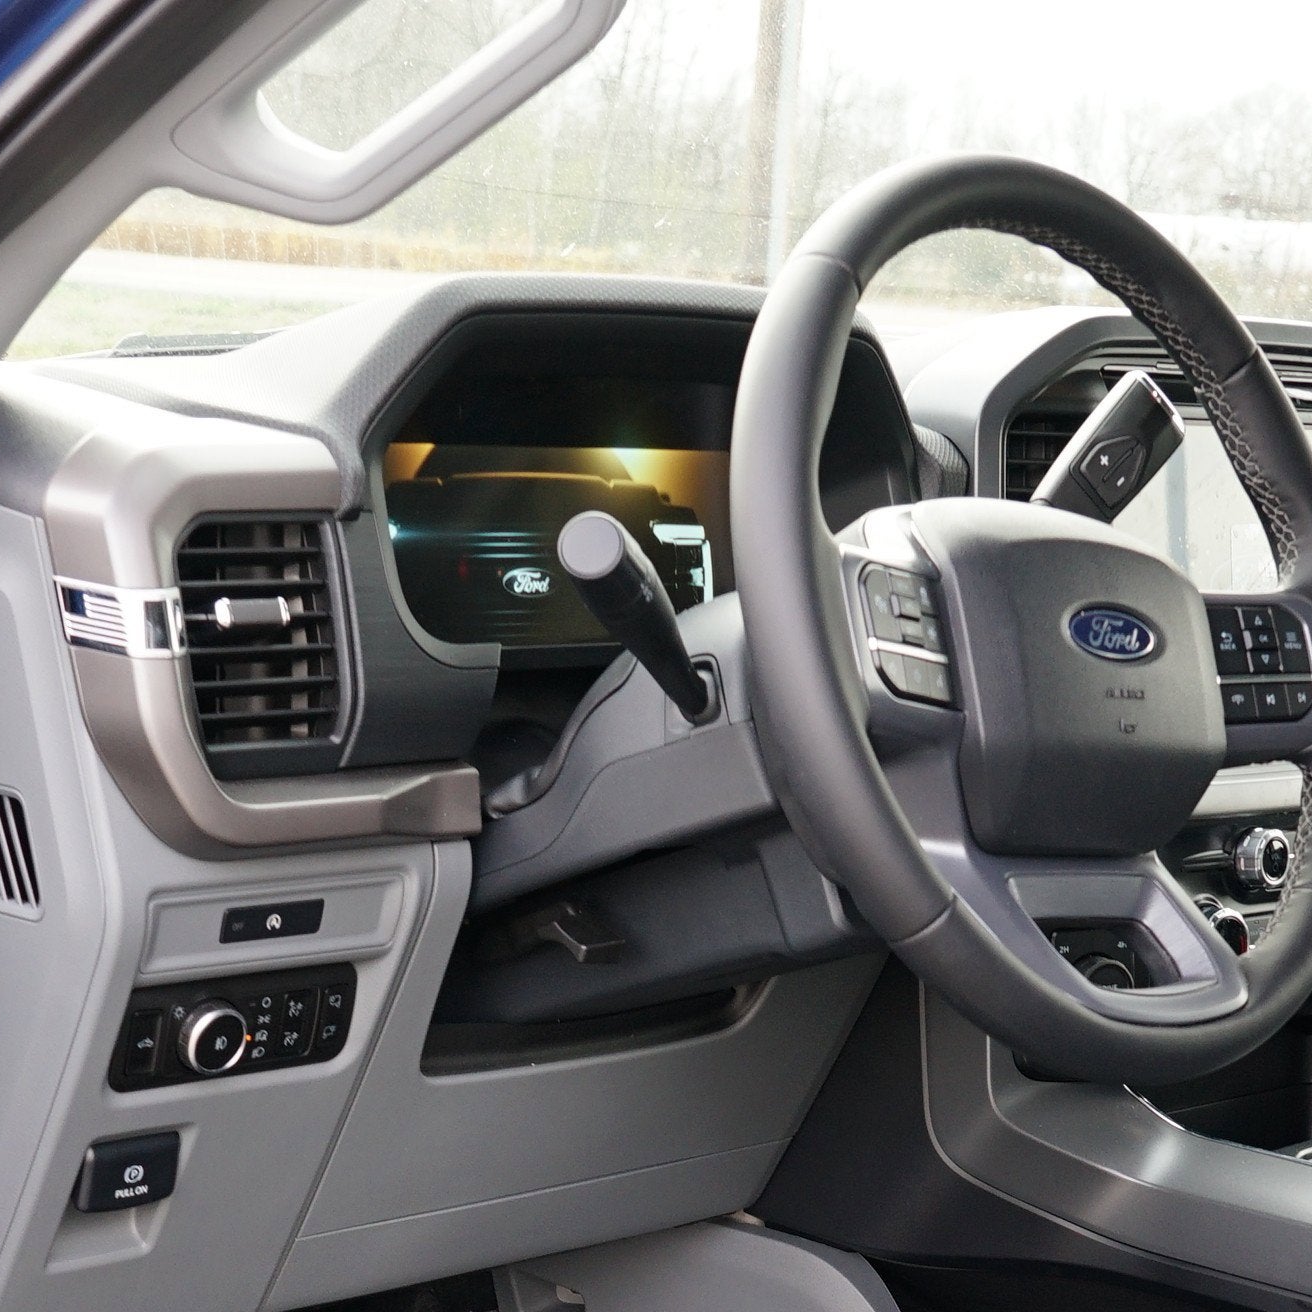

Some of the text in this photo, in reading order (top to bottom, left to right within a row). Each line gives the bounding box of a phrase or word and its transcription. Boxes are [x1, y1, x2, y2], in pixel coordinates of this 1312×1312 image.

[513, 571, 551, 594] Ford
[1088, 617, 1140, 652] Ford
[1283, 642, 1302, 651] MENU
[114, 1184, 149, 1200] PULL ON
